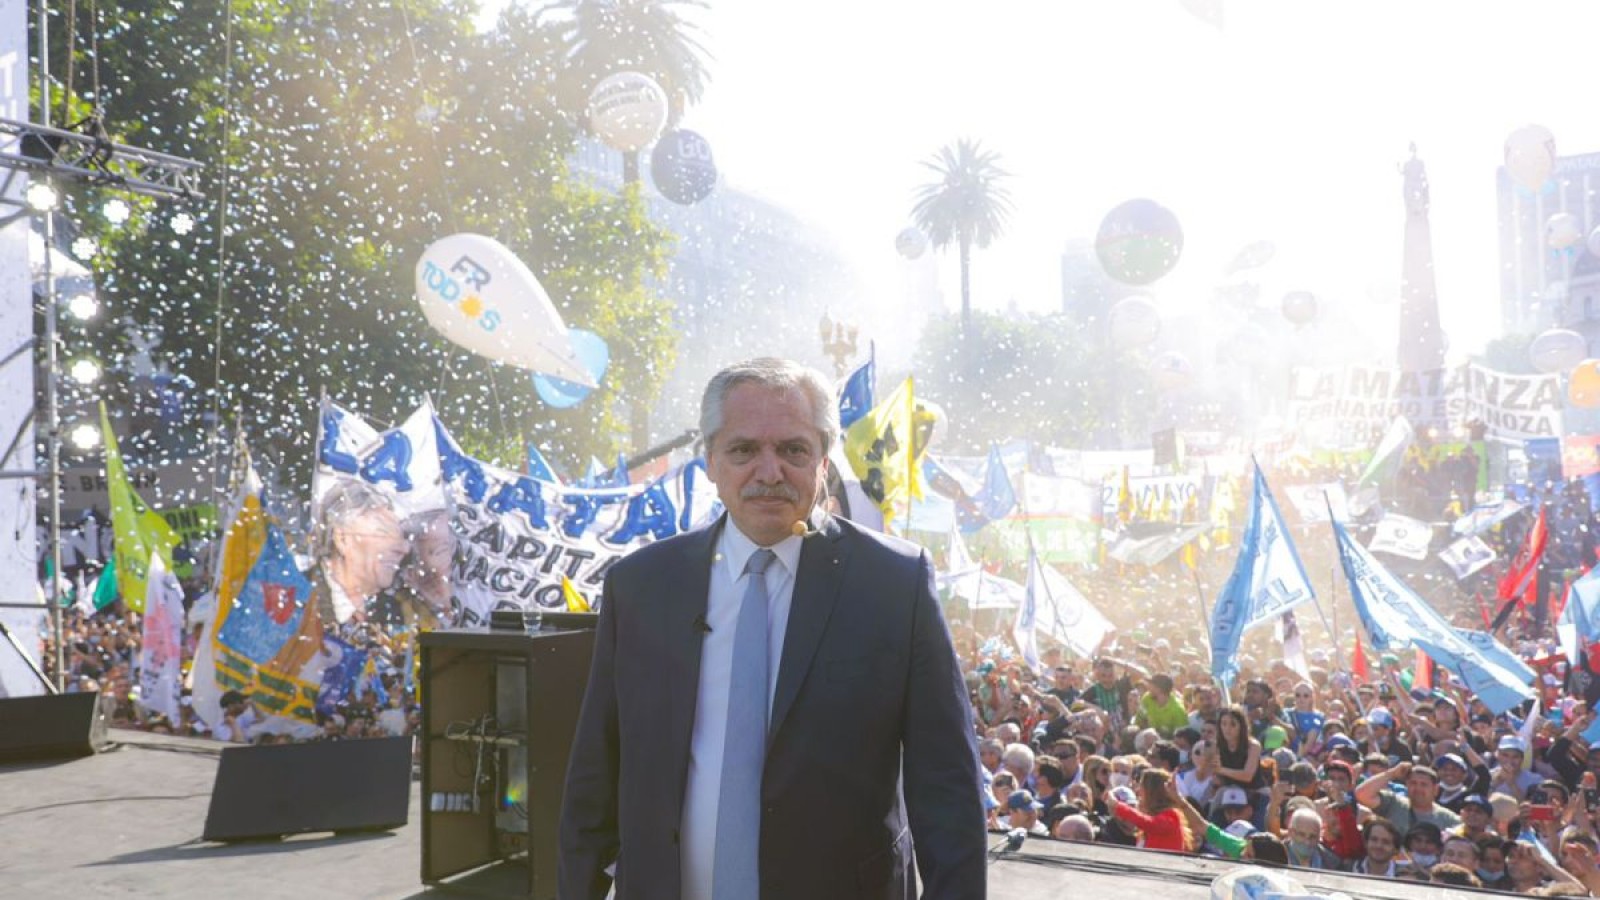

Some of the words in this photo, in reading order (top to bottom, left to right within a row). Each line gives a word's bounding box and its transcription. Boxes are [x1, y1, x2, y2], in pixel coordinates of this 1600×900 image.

[1289, 367, 1336, 401] LA
[1349, 366, 1563, 411] MATANZA
[1296, 398, 1422, 422] FERNANDO
[1432, 396, 1554, 436] ESPINOZA
